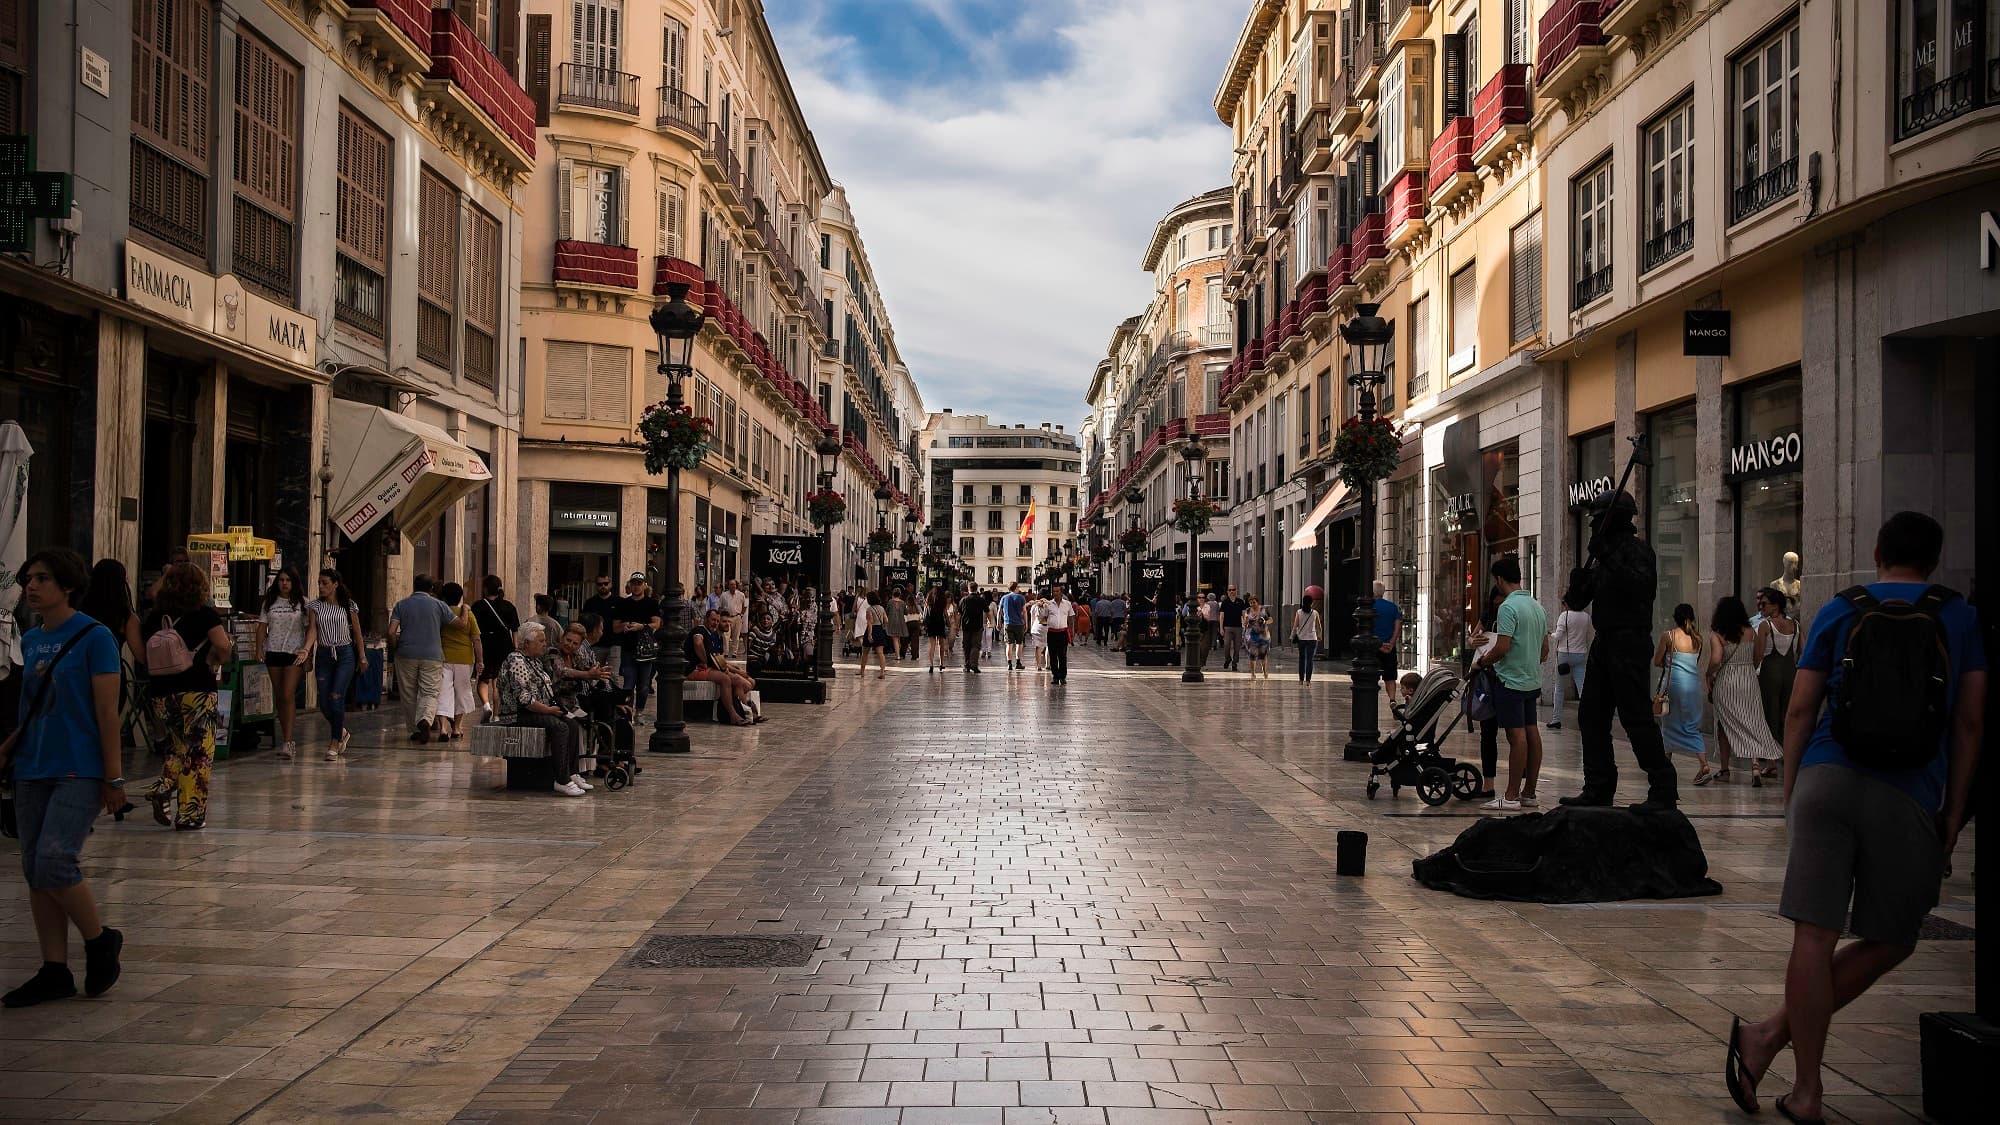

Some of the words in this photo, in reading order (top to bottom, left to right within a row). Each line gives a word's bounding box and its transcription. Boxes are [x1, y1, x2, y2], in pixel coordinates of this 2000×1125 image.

[130, 256, 193, 311] FARMACIA
[269, 314, 307, 353] MATA
[1689, 329, 1727, 337] MANGO
[1731, 432, 1801, 475] MANGO
[1569, 475, 1612, 506] MANGO
[561, 512, 611, 521] intimissimi
